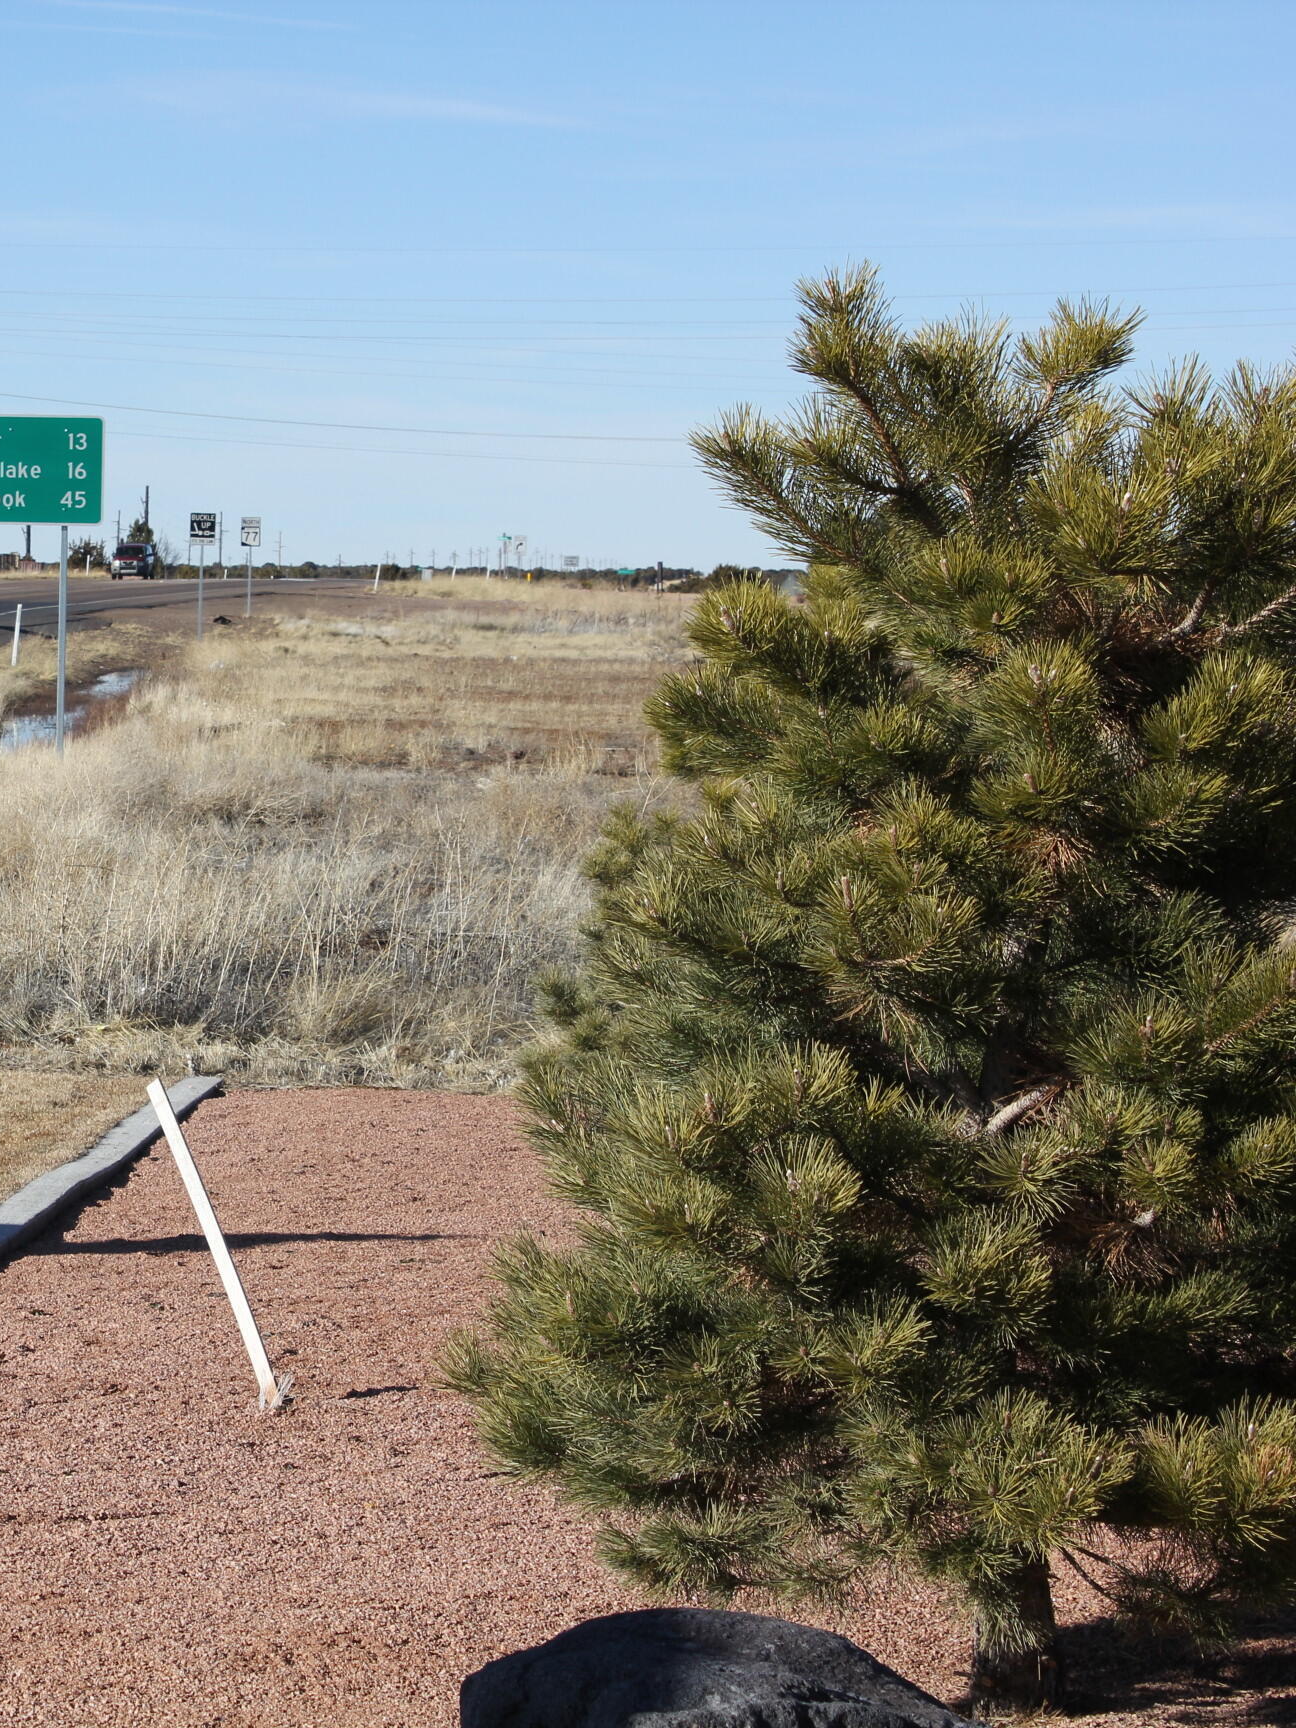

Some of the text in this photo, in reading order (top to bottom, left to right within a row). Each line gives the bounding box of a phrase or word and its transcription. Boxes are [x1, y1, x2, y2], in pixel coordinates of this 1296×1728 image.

[68, 433, 87, 450] 13
[67, 462, 87, 479] 16
[60, 491, 87, 509] 45
[201, 521, 212, 529] UP
[244, 531, 259, 542] 77
